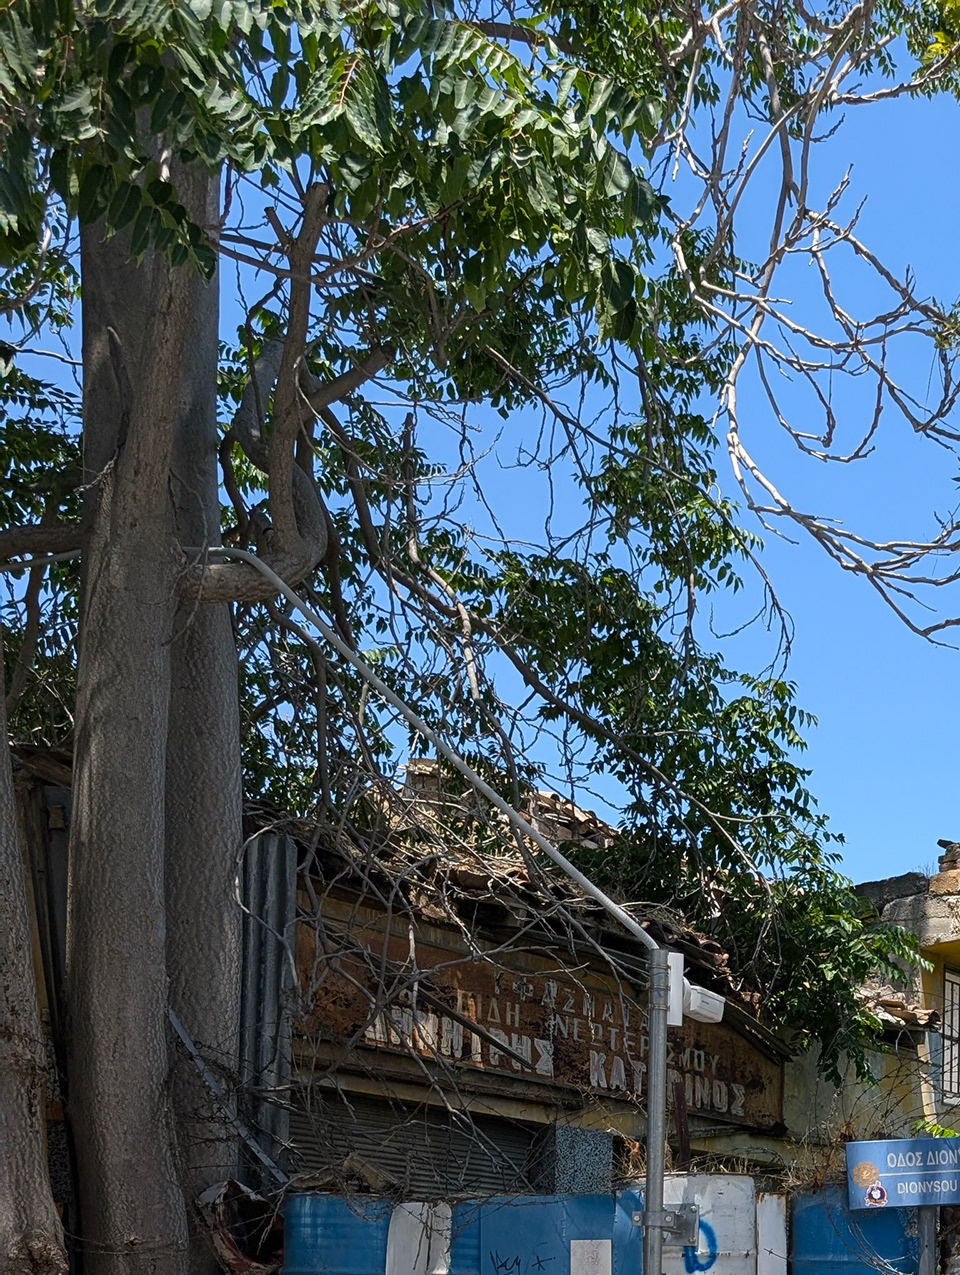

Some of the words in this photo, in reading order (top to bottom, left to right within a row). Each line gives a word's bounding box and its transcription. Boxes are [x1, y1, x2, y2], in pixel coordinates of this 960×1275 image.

[552, 1013, 720, 1075] ΝΕΩΤΕΡΣΜΟΥ
[886, 1152, 923, 1168] ΟΔΟΣ
[897, 1179, 958, 1195] DIONYSOU
